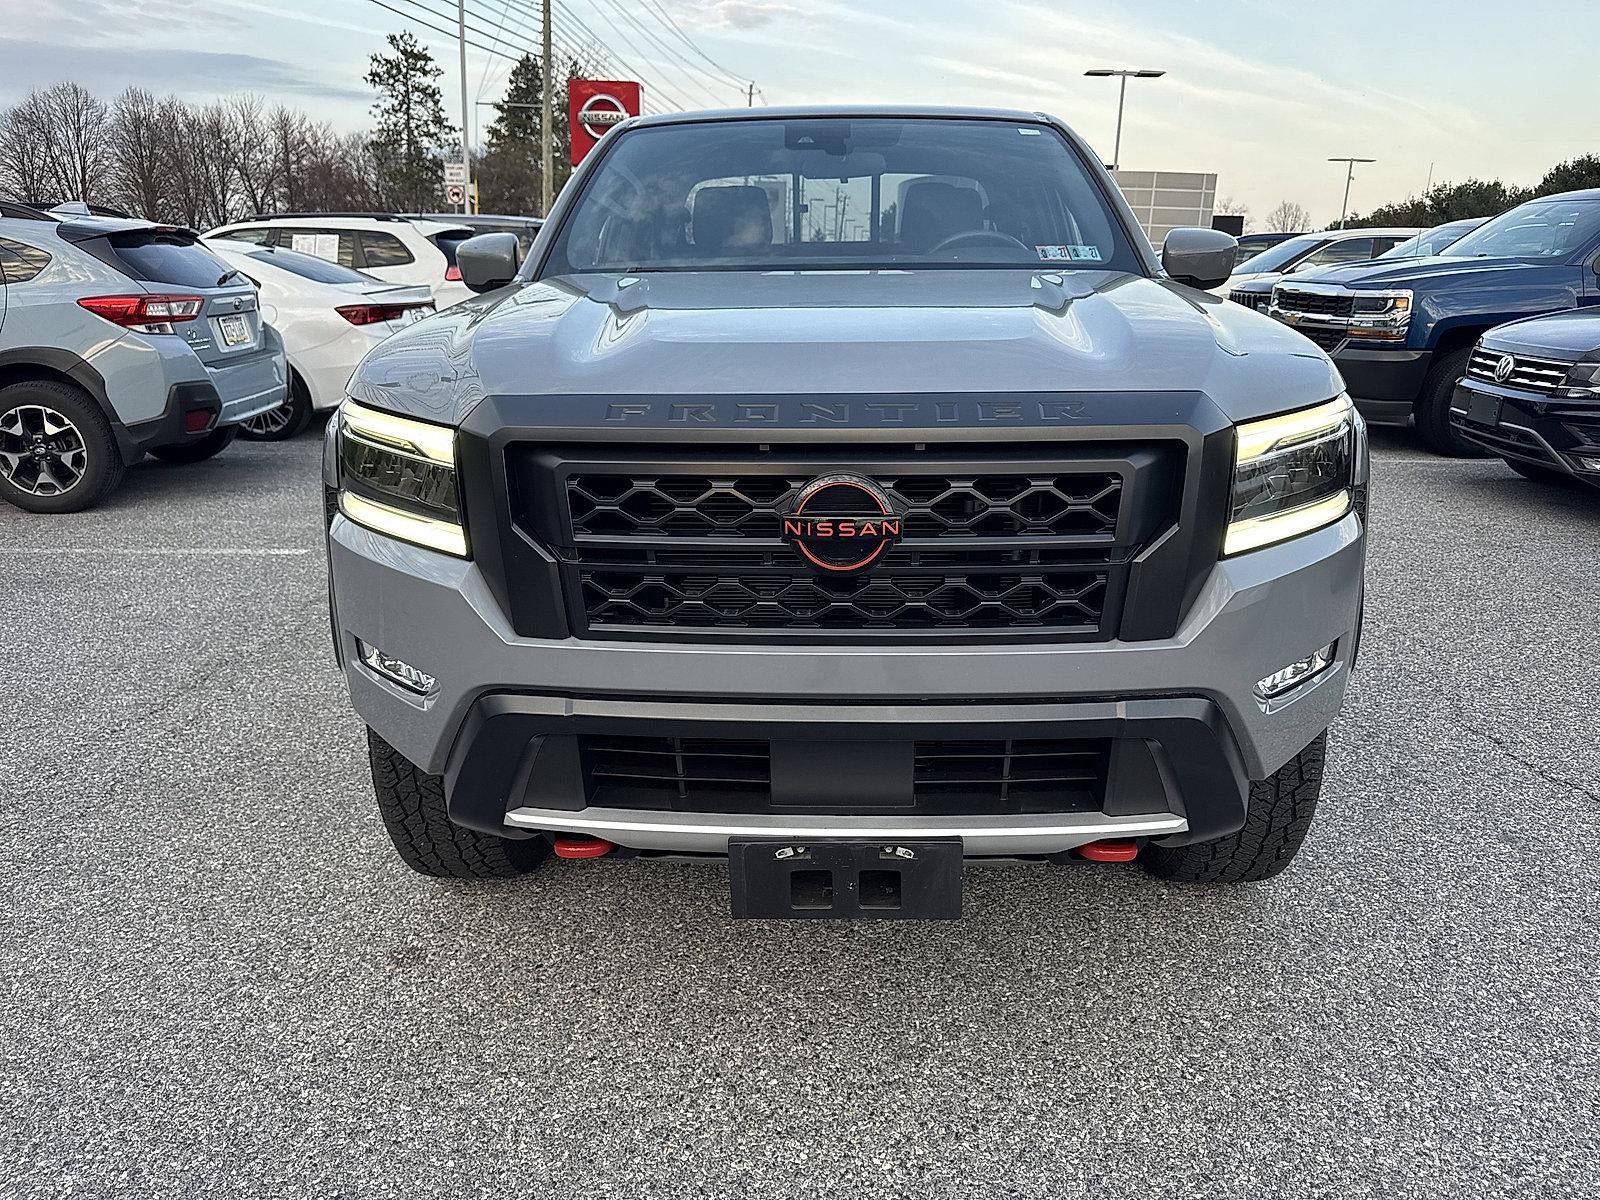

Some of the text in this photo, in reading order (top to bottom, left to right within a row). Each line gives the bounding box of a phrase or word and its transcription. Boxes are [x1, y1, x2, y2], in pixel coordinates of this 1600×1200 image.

[582, 113, 625, 122] NISSAN
[605, 401, 1091, 423] FRONTIER
[783, 520, 900, 537] NISSAN
